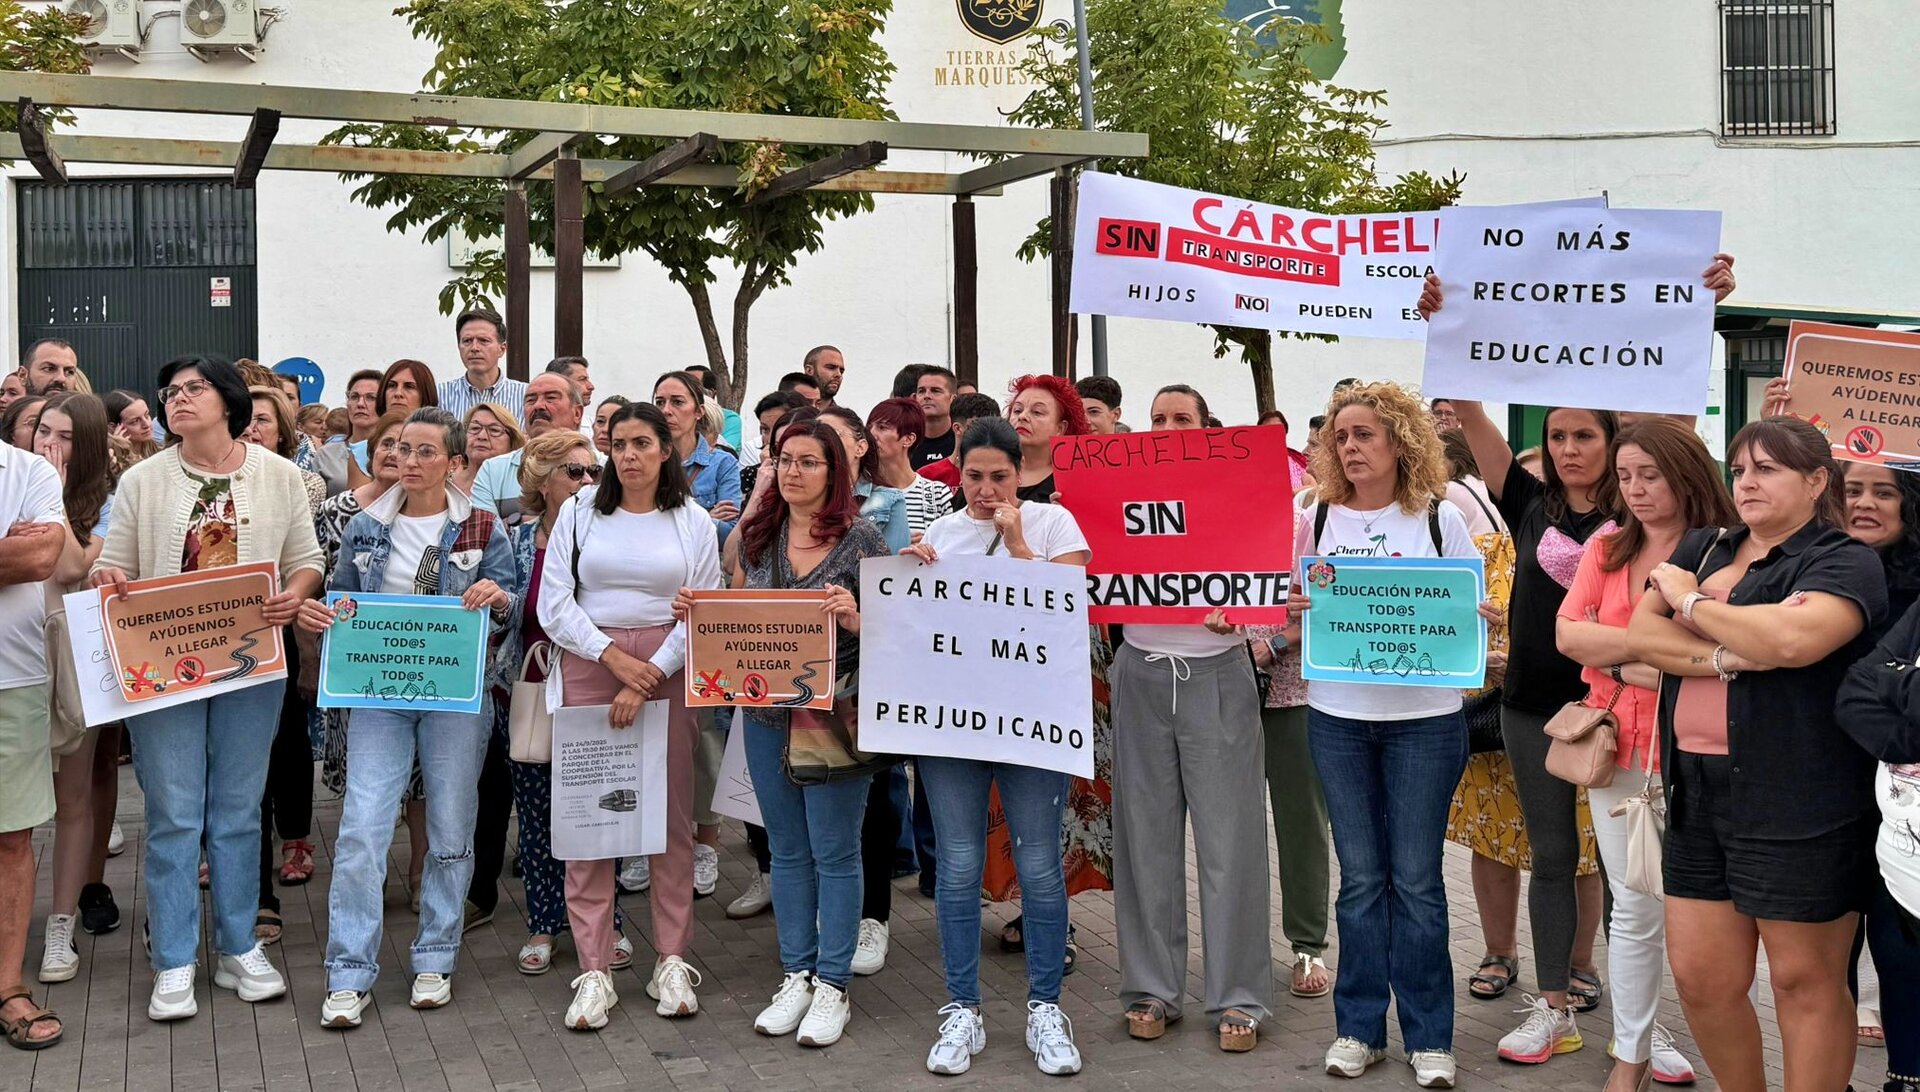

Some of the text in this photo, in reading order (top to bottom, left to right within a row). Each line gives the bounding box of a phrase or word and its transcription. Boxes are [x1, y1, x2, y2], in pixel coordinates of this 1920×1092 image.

[946, 51, 1016, 65] TIERRAS
[935, 67, 1060, 87] MARQUES
[1193, 197, 1439, 255] CÁRCHEL
[1483, 224, 1631, 251] NO MÁS
[1105, 224, 1435, 278] SIN TRANSPORTE ESCOLA
[1473, 281, 1693, 303] RECORTES EN
[1128, 284, 1422, 321] HIJOS NO PUEDEN ES
[1470, 341, 1663, 366] EDUCACIÓN
[1802, 361, 1893, 383] QUEREMOS
[1843, 408, 1855, 420] A
[1124, 502, 1186, 534] SIN
[1336, 545, 1374, 557] Cherry
[878, 562, 1075, 613] CÁRCHELES
[1086, 572, 1290, 607] RANSPORTE
[1332, 583, 1451, 599] EDUCACIÓN PARA
[116, 607, 194, 629] QUEREMOS
[198, 594, 264, 615] ESTUDIAR
[1367, 604, 1415, 616] TOD@S
[149, 617, 235, 642] AYÚDENNOS
[352, 619, 458, 633] EDUCACIÓN PARA
[697, 623, 823, 635] QUEREMOS ESTUDIAR
[1329, 621, 1457, 636] TRANSPORTE PARA
[164, 635, 228, 657] A LLEGAR
[382, 637, 426, 649] TOD@S
[724, 639, 798, 652] AYÚDENNOS
[933, 627, 1047, 664] EL MÁS
[1368, 641, 1417, 654] TOD@S
[346, 652, 459, 667] TRANSPORTE PARA
[736, 659, 791, 670] A LLEGAR
[381, 670, 424, 682] TOD@S
[876, 702, 1083, 749] PERJUDICADO
[568, 752, 613, 760] CONCENTRAR
[562, 772, 604, 780] SUSPENSIÓN
